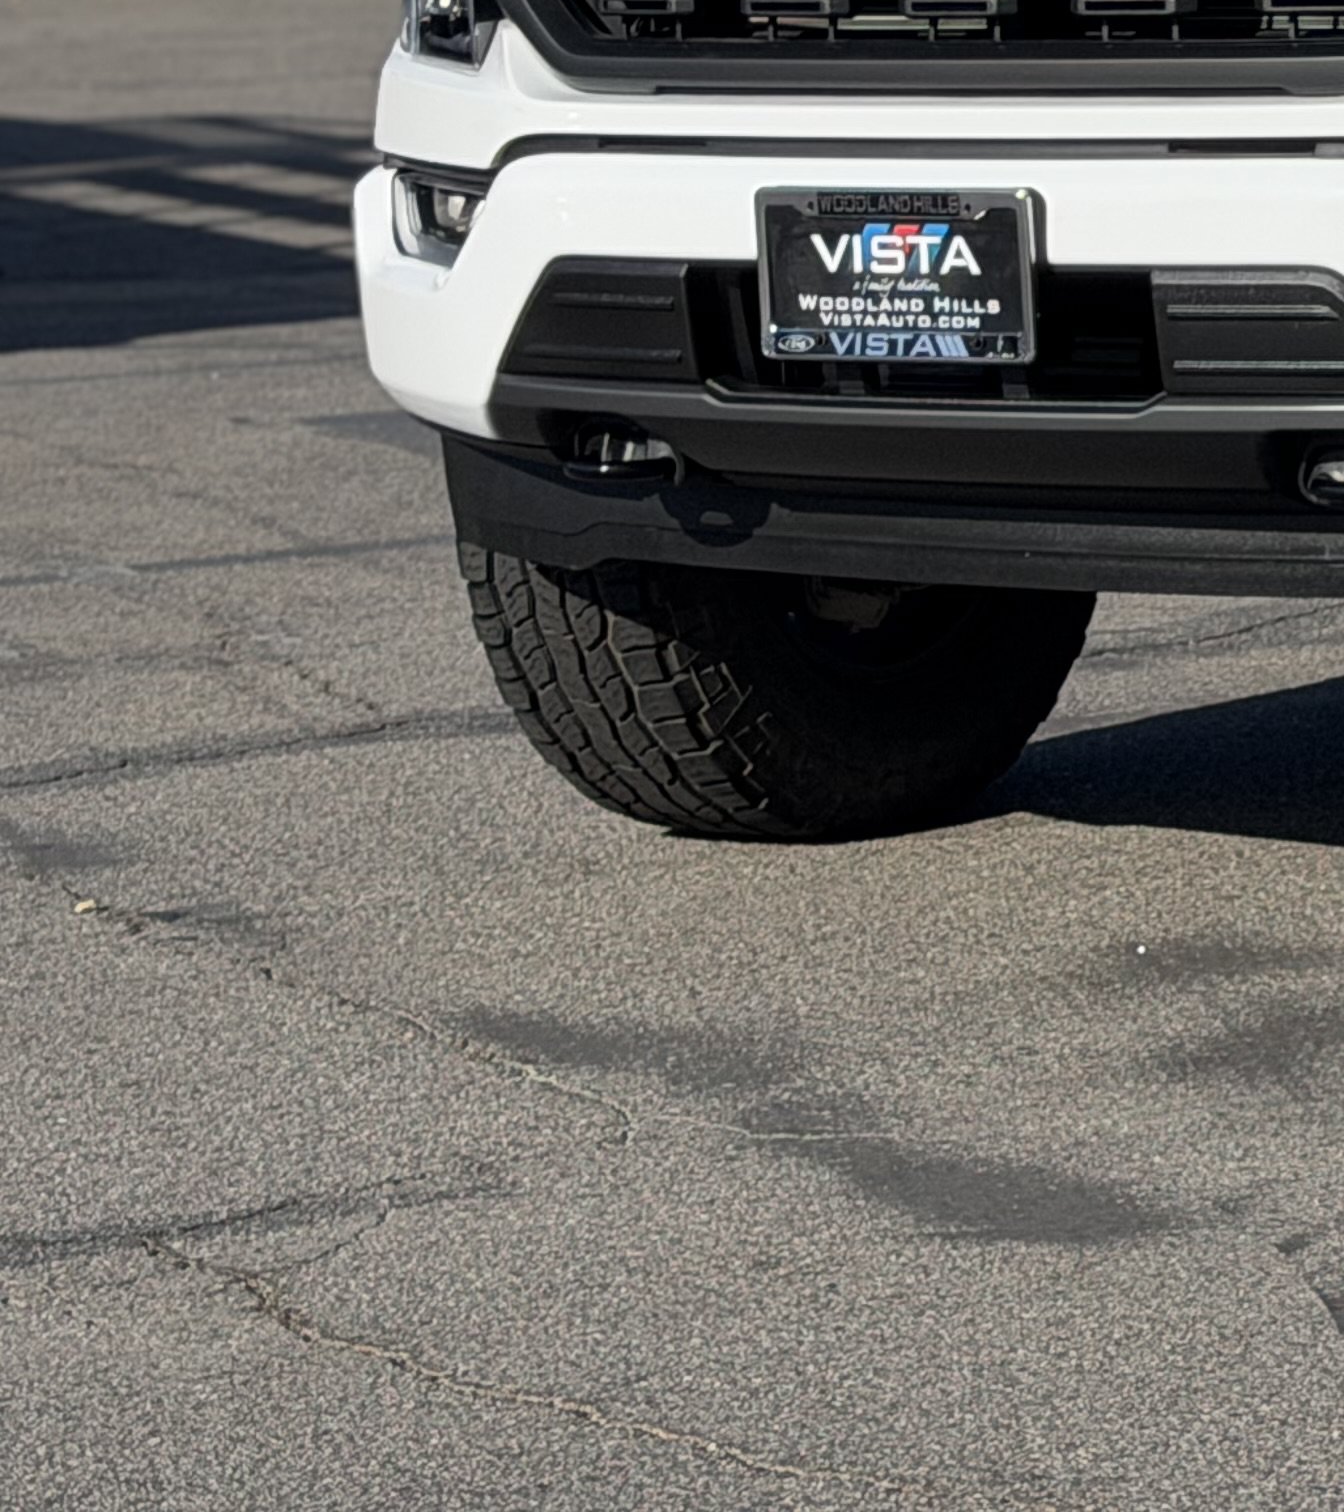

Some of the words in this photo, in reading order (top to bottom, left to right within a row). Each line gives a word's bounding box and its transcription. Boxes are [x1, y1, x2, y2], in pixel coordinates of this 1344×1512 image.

[818, 194, 911, 214] WOODLAND
[913, 194, 960, 215] HILLS
[810, 233, 982, 275] VISTA
[799, 293, 925, 312] WOODLAND
[933, 295, 1001, 315] HILLS
[829, 332, 937, 357] VISTA
